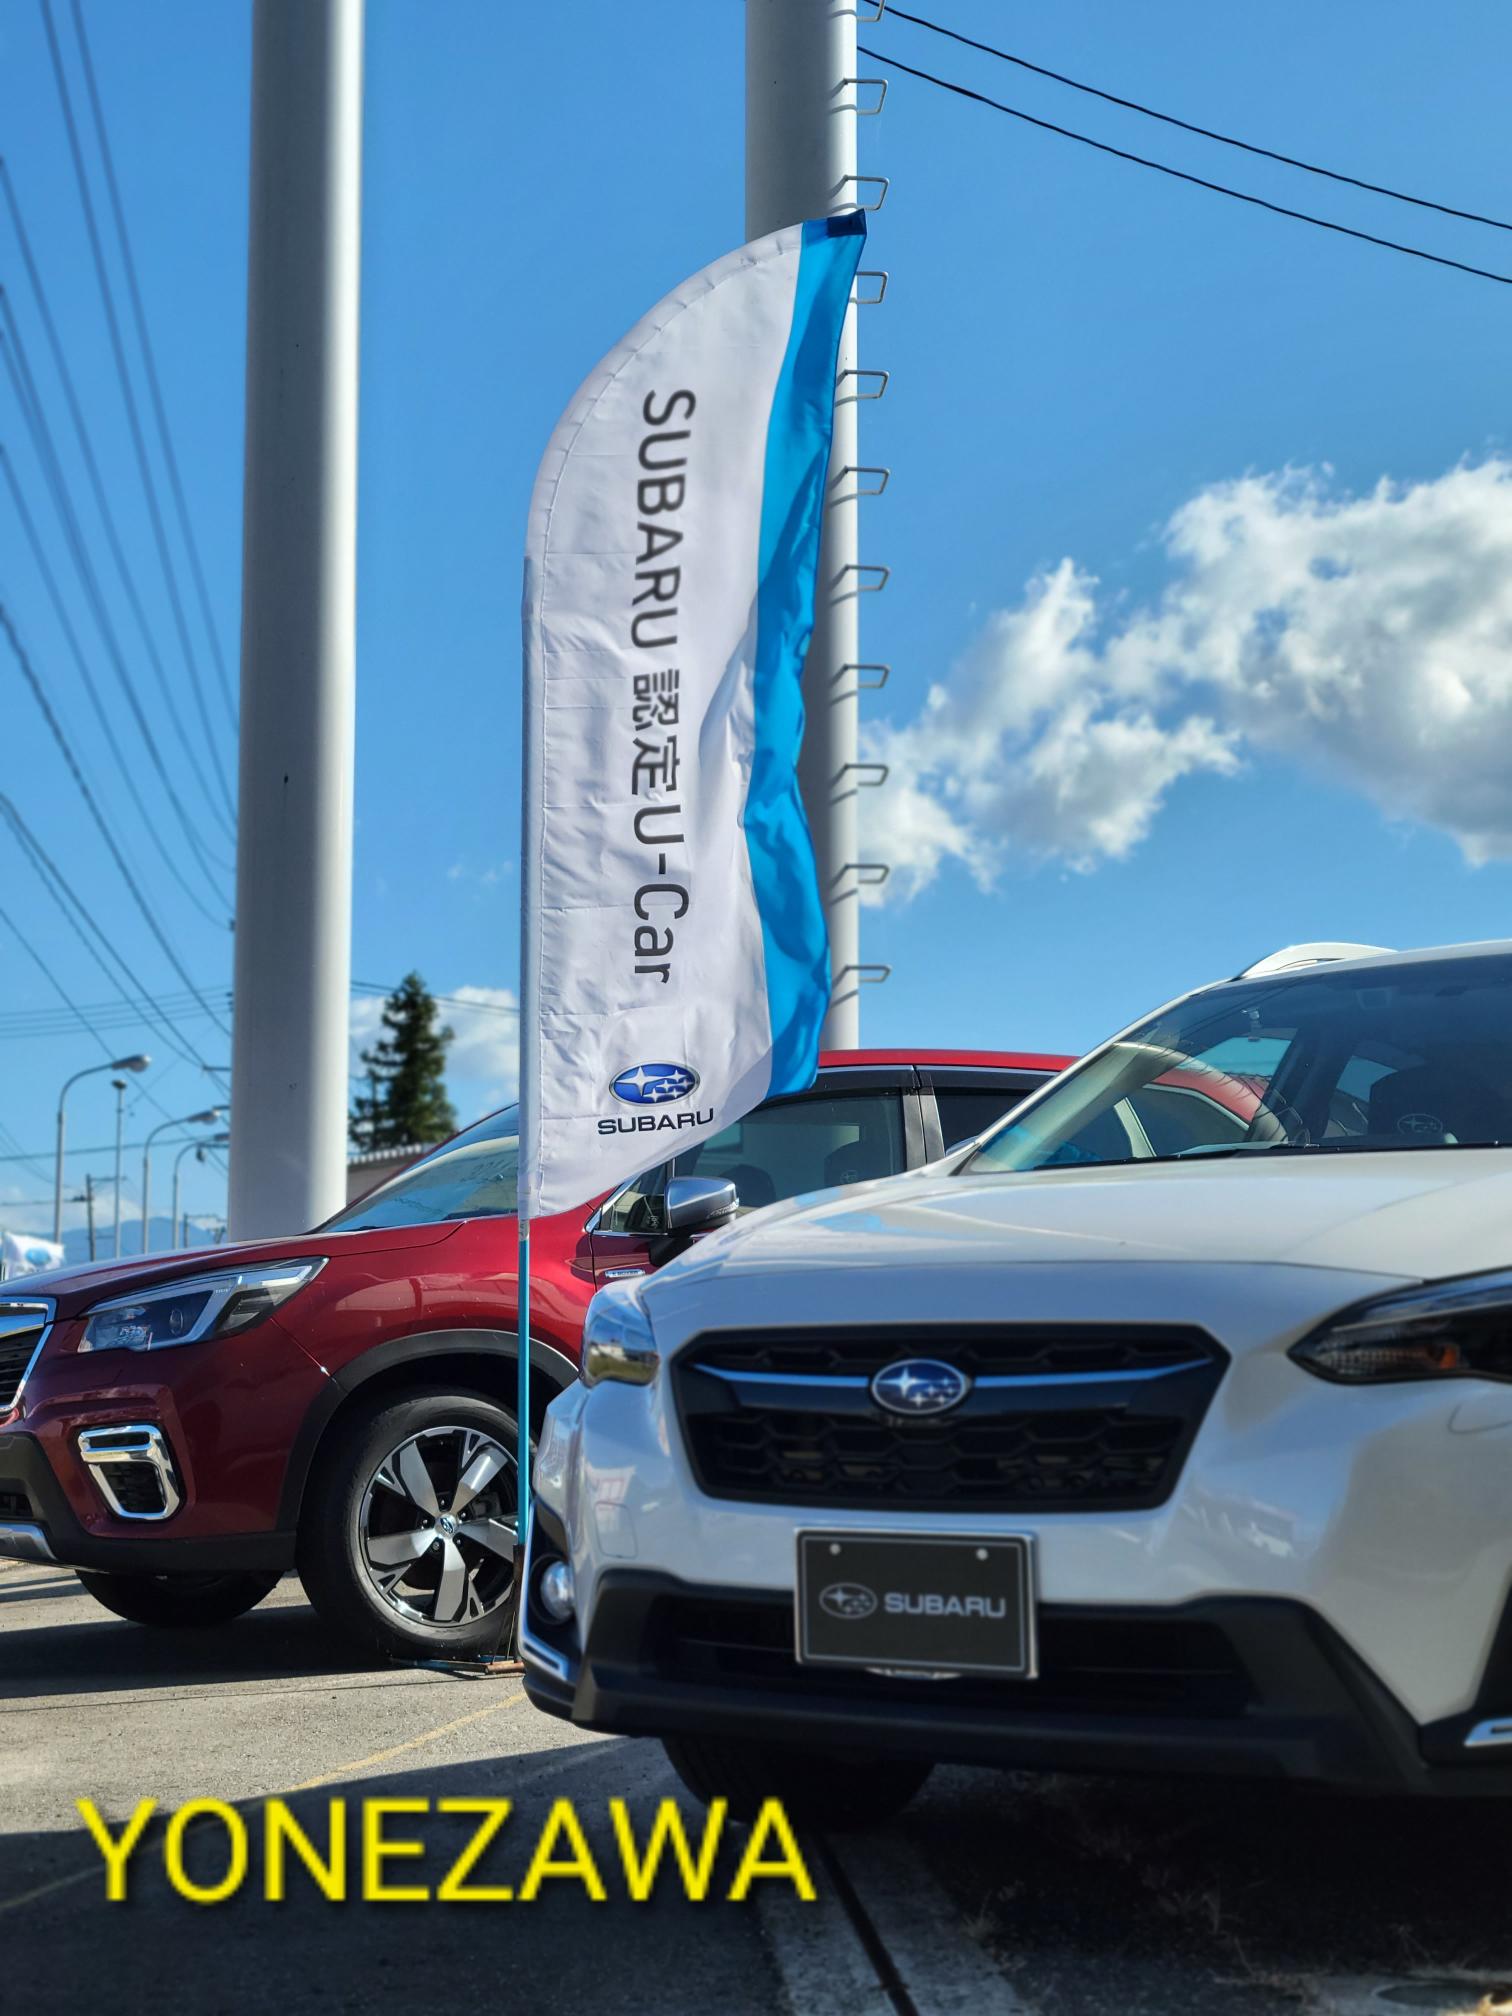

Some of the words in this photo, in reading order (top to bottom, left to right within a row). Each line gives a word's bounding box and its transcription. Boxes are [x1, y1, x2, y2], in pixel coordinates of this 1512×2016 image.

[632, 390, 697, 649] SUBARU
[630, 668, 690, 984] 認定U-Car
[597, 1107, 714, 1136] SUBARU
[884, 1593, 1006, 1618] SUBARU
